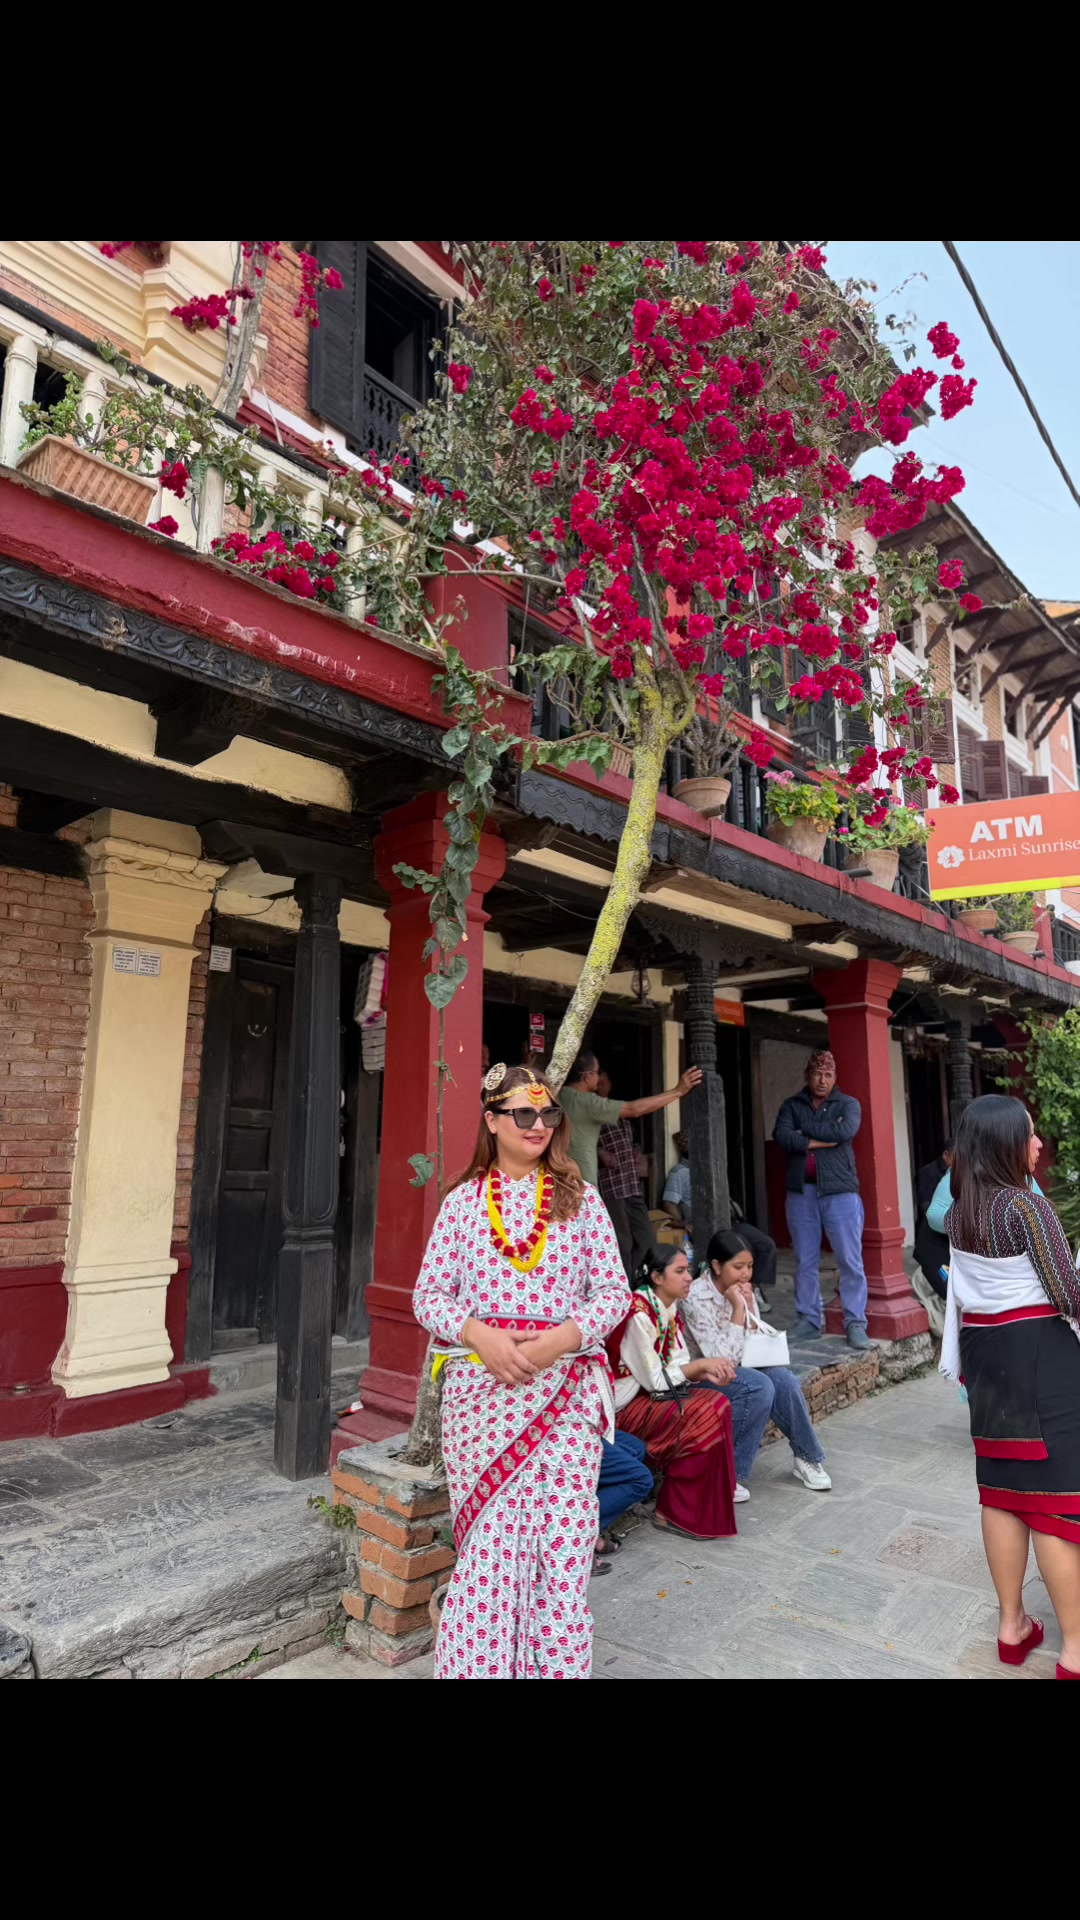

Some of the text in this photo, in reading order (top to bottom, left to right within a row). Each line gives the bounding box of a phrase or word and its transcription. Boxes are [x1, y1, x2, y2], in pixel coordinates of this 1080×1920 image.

[970, 814, 1043, 843] ATM
[969, 838, 1080, 861] Laxmi Sunrise
